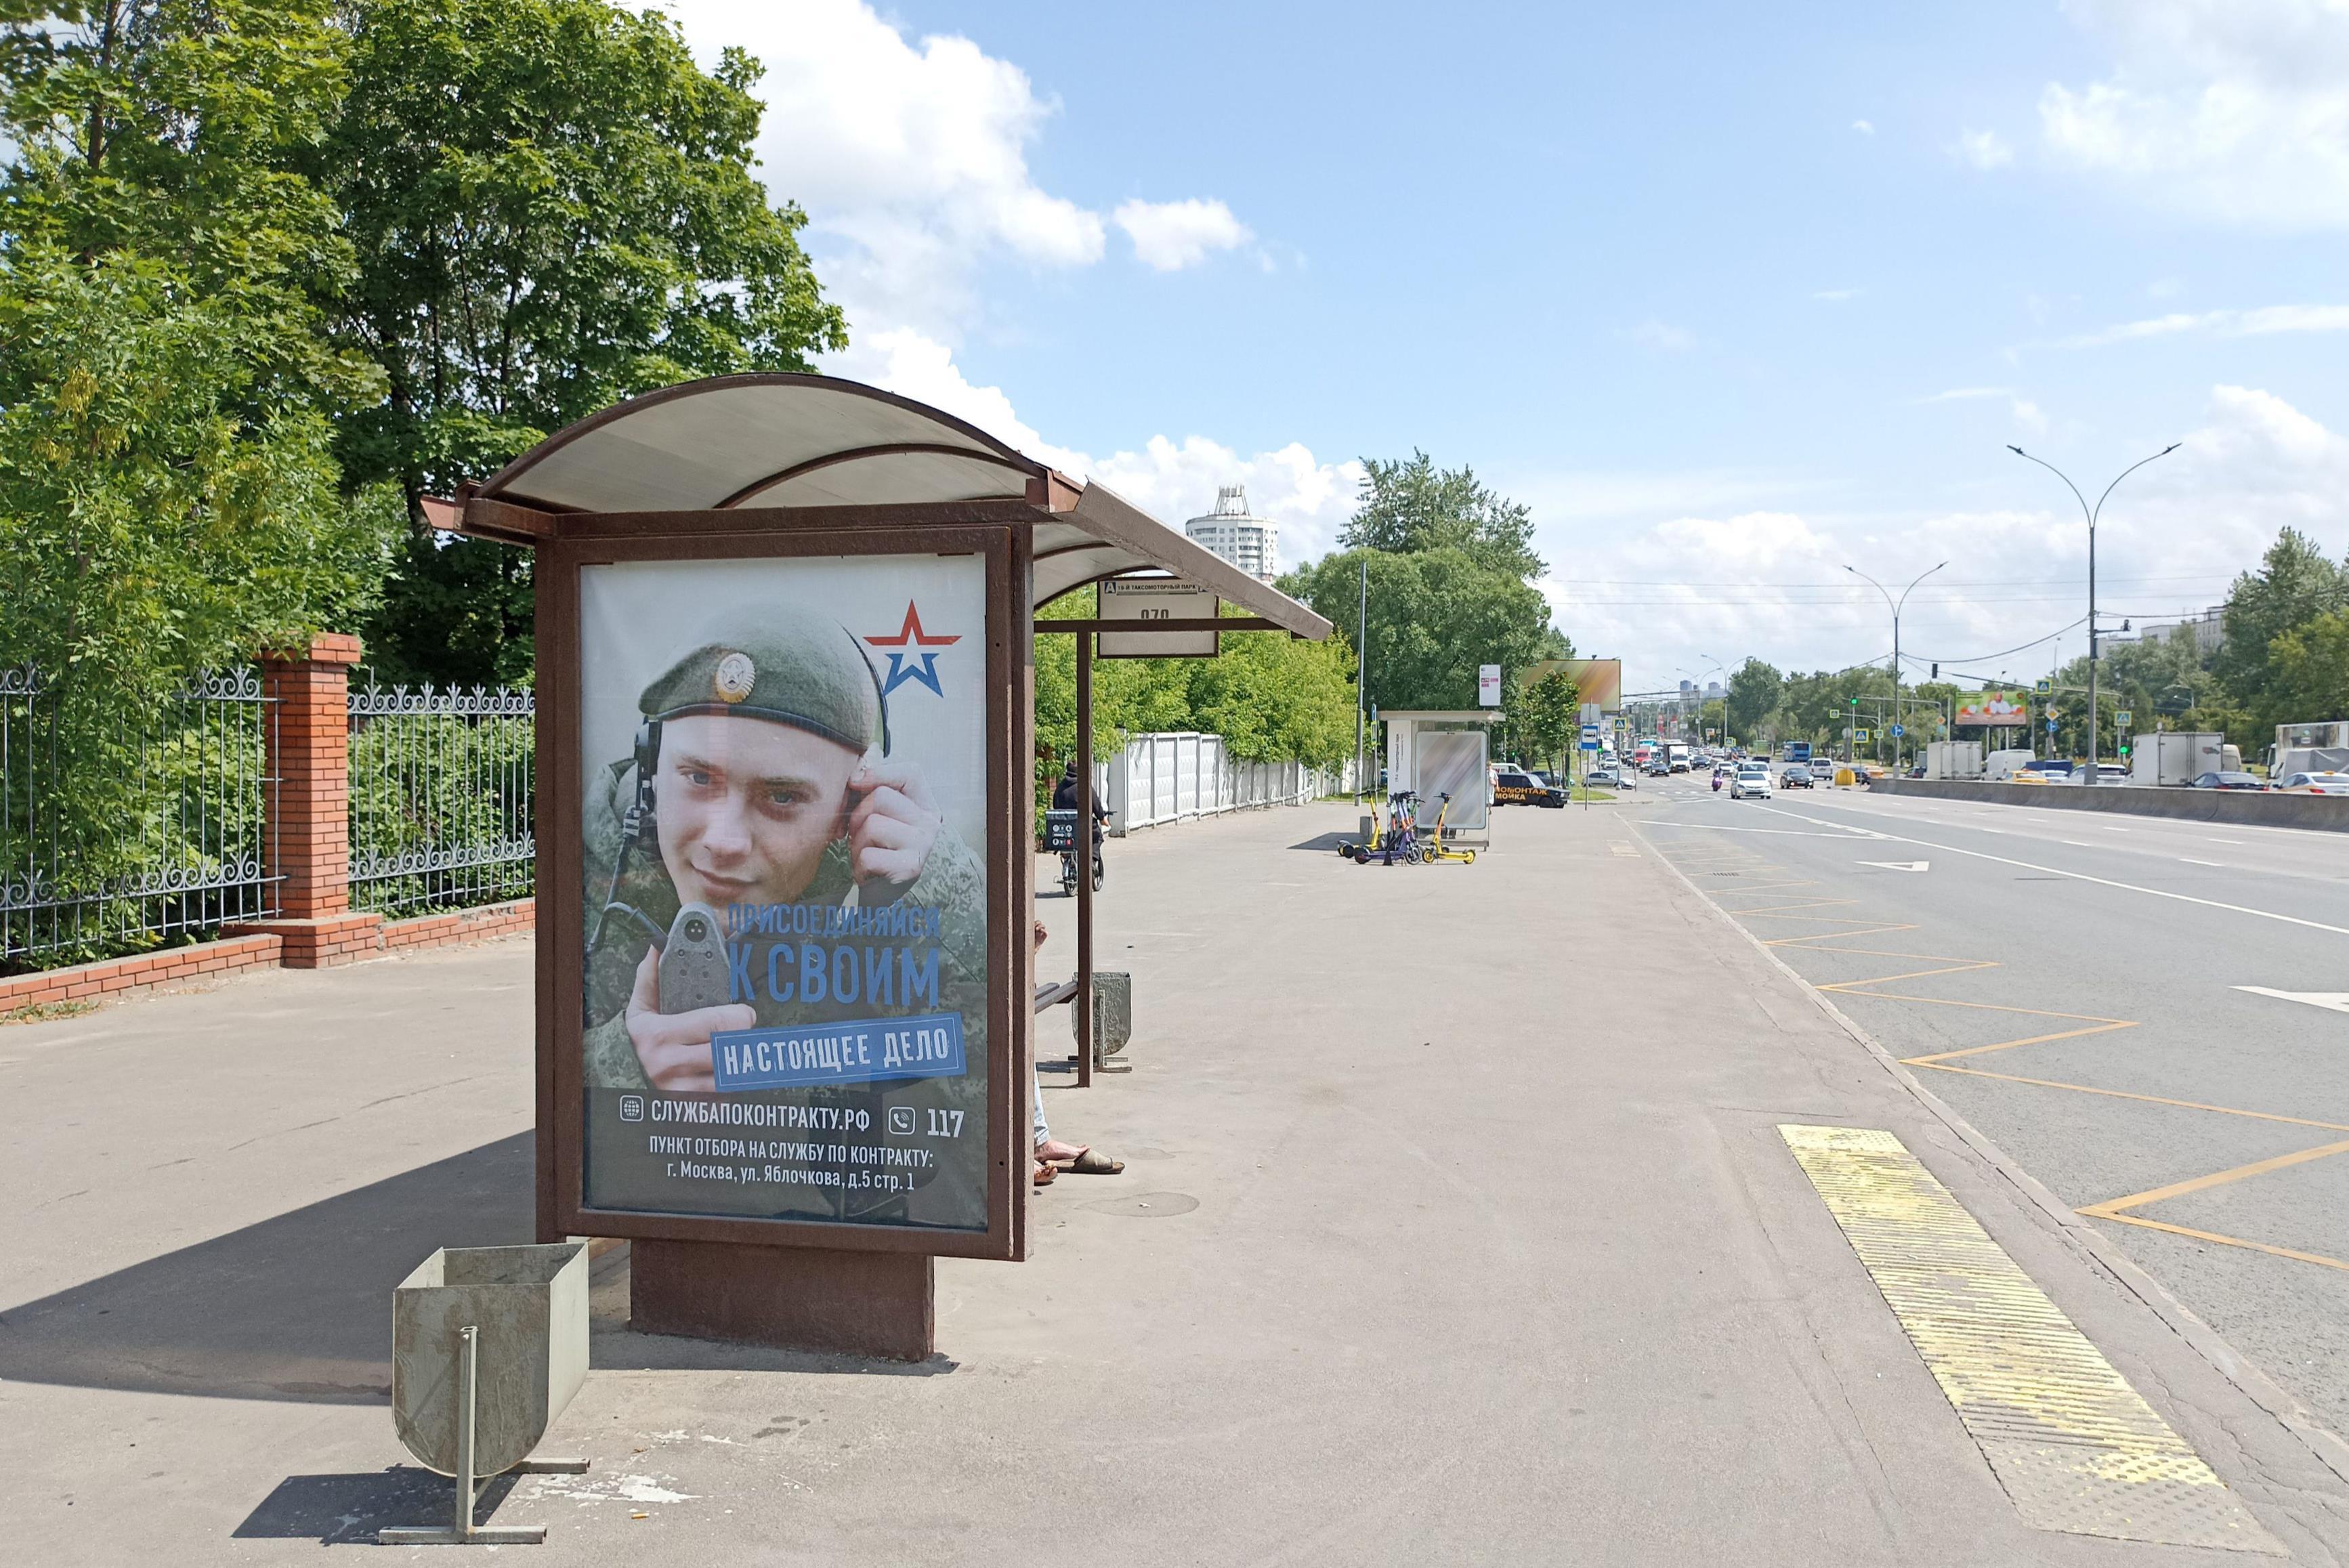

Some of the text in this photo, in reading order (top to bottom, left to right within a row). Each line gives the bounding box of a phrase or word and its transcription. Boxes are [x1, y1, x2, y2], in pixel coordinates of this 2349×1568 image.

[727, 899, 941, 938] ПРИСОЕДИНЯЙСЯ
[727, 942, 940, 1007] К СВОИМ
[723, 1027, 949, 1076] НАСТОЯЩЕЕ ДЕЛО
[652, 1099, 870, 1132] СЛУЖБАПОКОНТРАКТУ.РФ
[927, 1108, 965, 1138] 117
[650, 1135, 933, 1168] ПУНКТ ОТБОРА НА СЛУЖБУ ПО КОНТРАКТУ:
[667, 1160, 914, 1193] г. Москва, ул. Яблочкова, д.5 стр. 1
